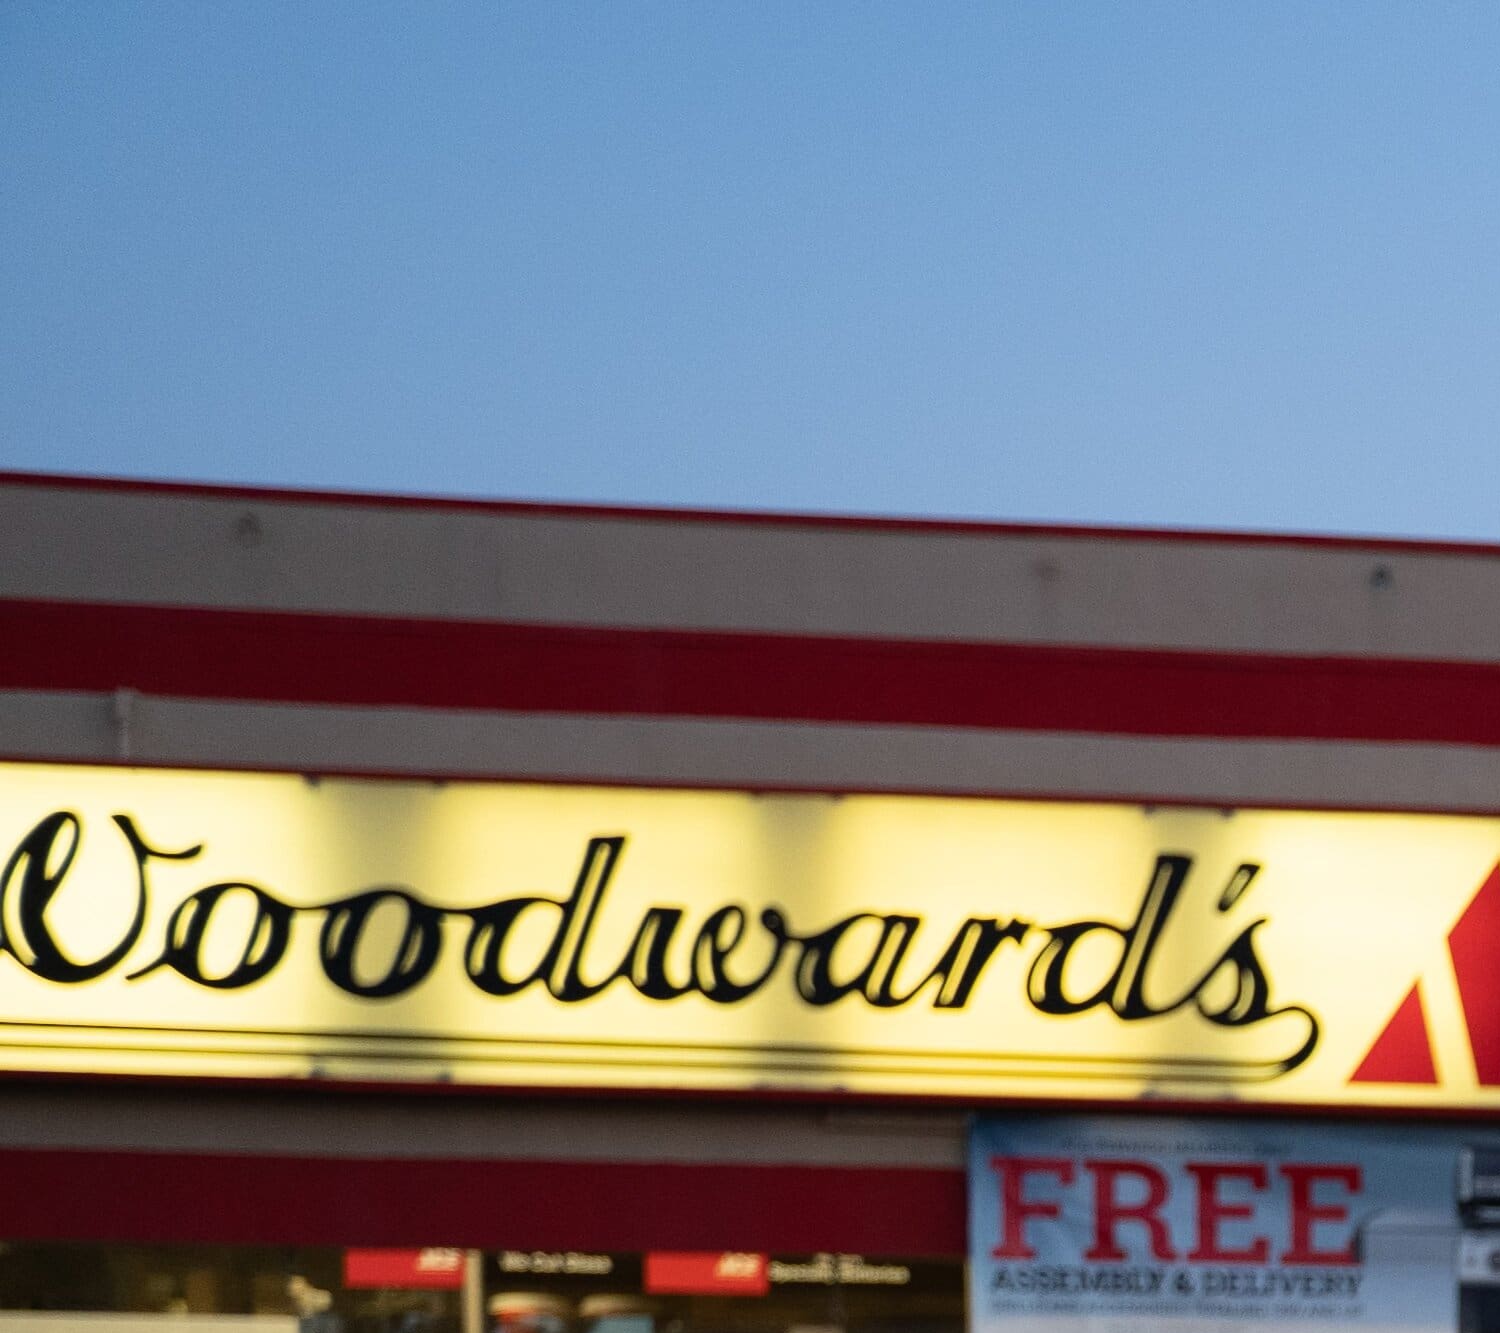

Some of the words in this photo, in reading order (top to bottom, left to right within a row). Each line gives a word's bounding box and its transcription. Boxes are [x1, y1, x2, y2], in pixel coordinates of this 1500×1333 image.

[0, 808, 1320, 1062] Woodward's
[988, 1155, 1364, 1268] FREE
[991, 1266, 1166, 1297] ASSEMBLY
[1202, 1269, 1364, 1301] DELIVERY
